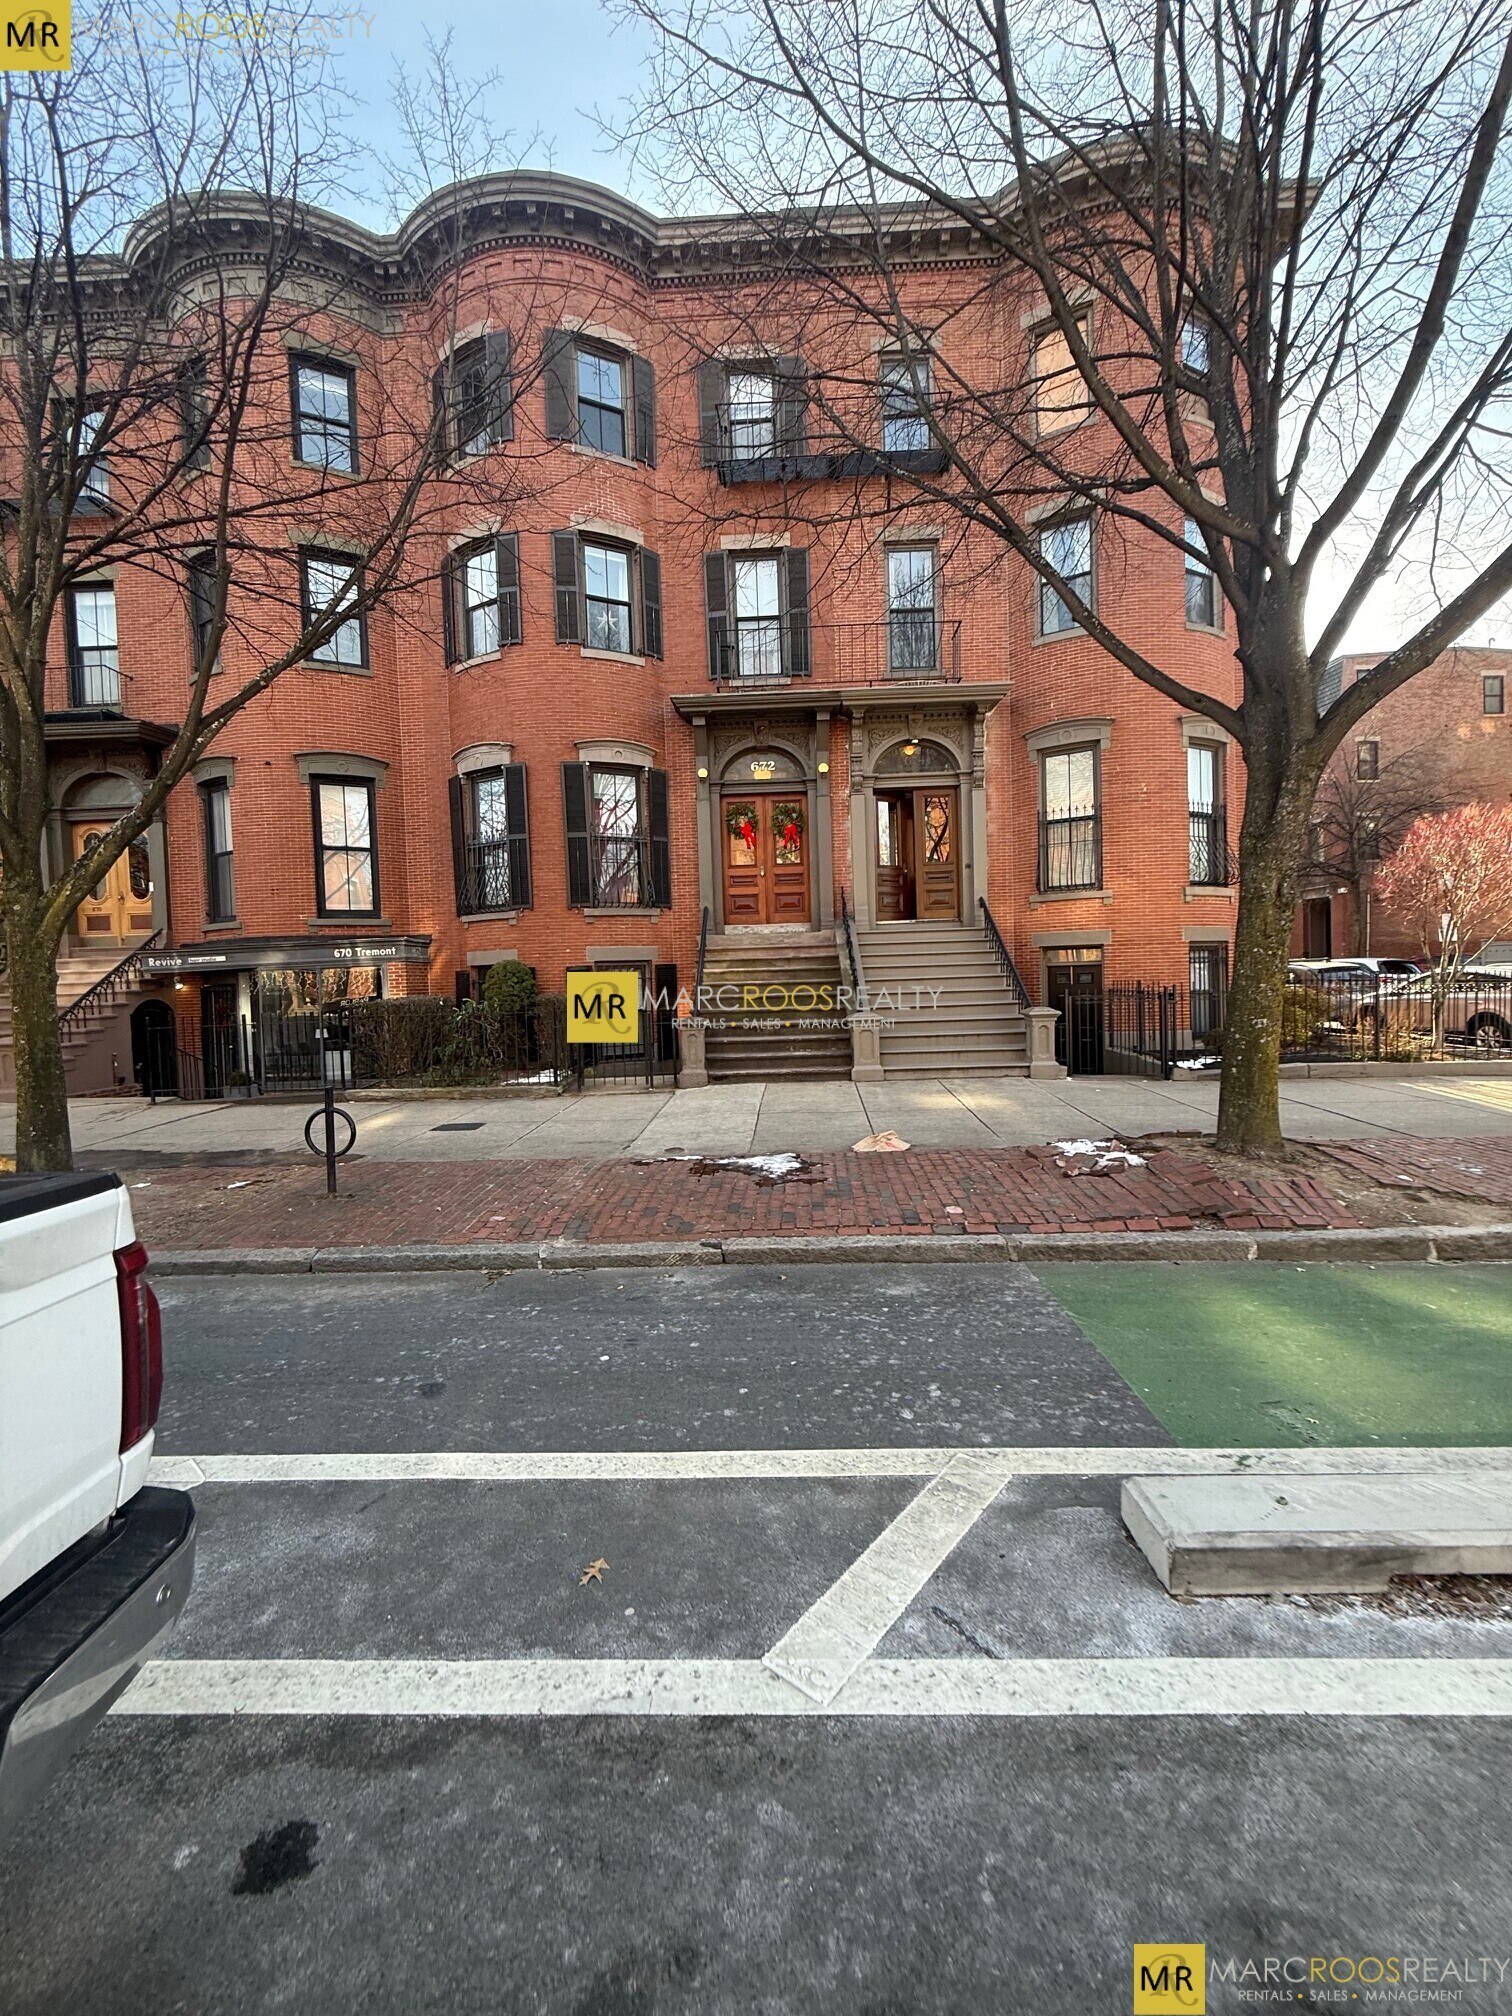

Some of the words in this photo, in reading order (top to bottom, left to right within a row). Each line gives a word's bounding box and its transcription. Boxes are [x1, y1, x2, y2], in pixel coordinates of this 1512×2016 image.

[750, 760, 776, 772] 672
[333, 947, 353, 958] 670
[354, 946, 397, 957] Tremont
[148, 957, 183, 967] Revive
